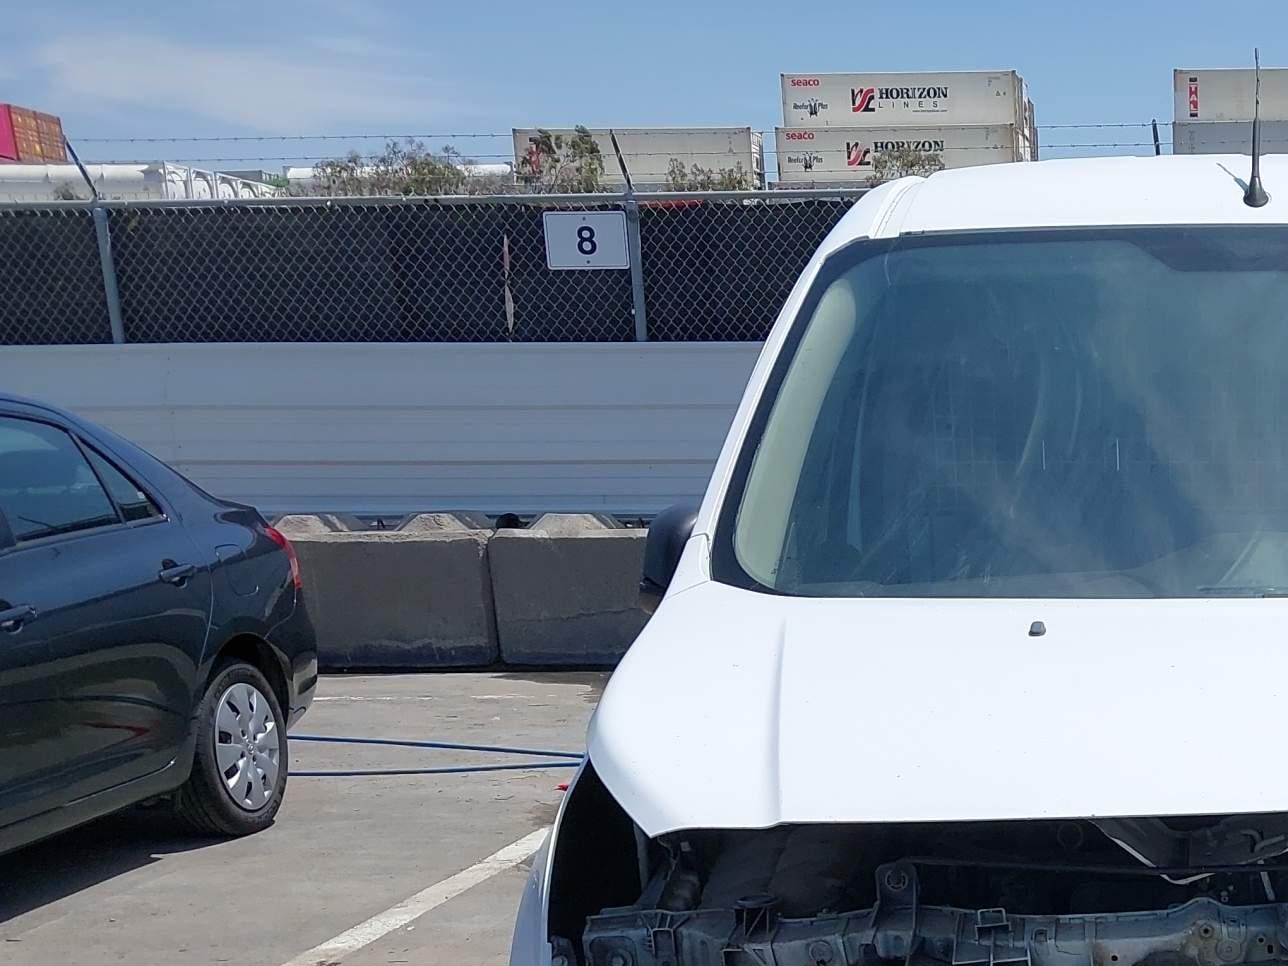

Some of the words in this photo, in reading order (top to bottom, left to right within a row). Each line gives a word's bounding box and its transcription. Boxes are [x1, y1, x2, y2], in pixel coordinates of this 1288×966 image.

[791, 79, 820, 87] seaco
[878, 87, 949, 99] HORIZON
[785, 132, 815, 140] seaco
[577, 226, 597, 255] 8
